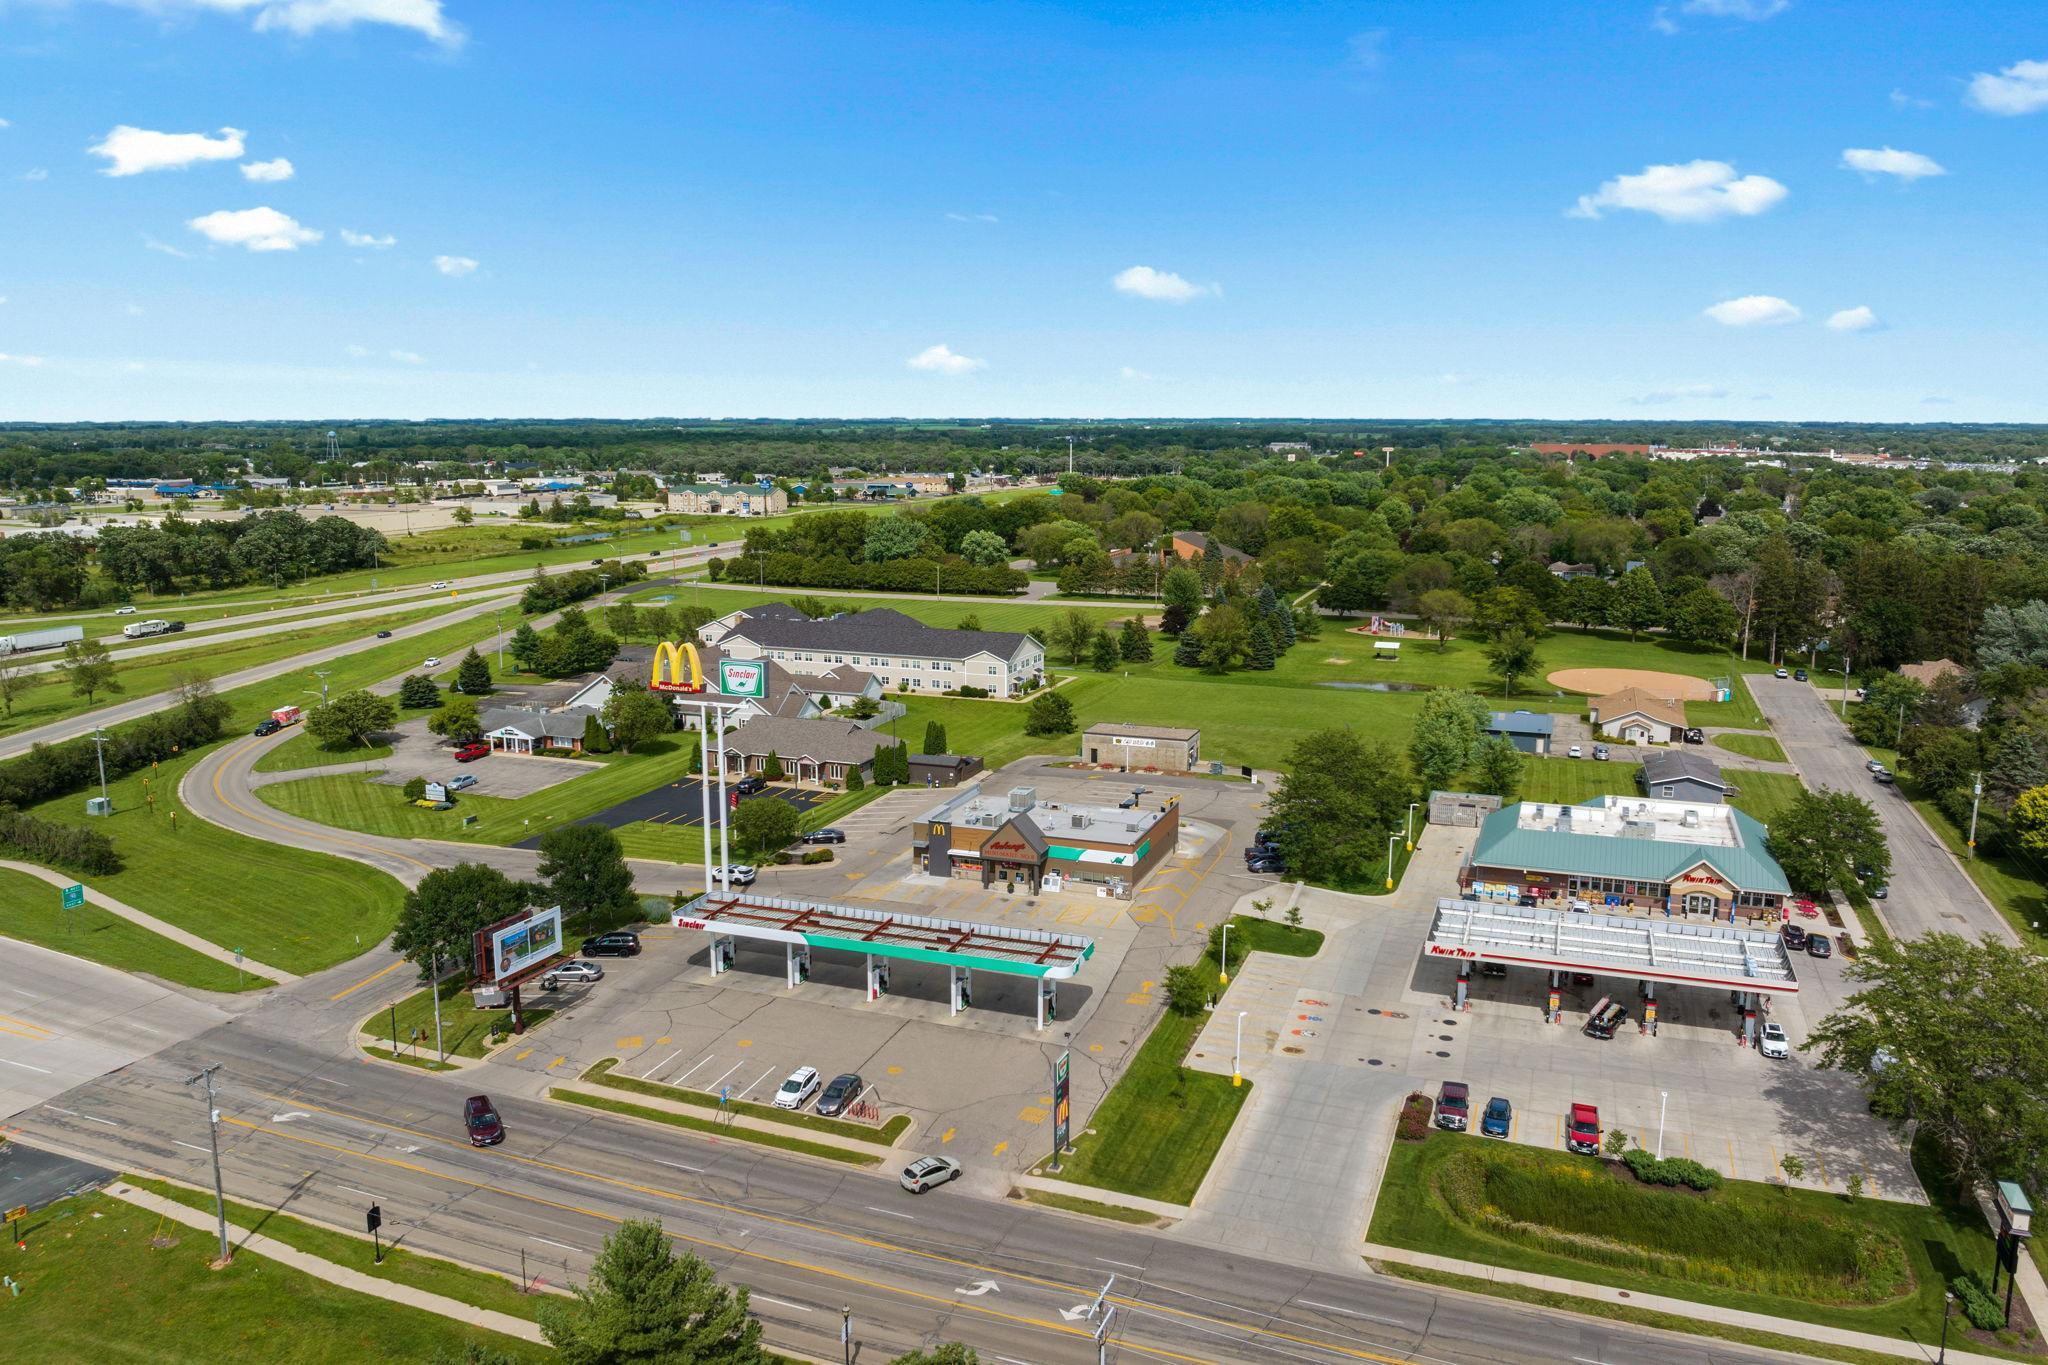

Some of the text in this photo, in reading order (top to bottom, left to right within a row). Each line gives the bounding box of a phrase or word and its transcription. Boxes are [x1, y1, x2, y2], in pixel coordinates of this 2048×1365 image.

[728, 668, 756, 679] Sinclair
[678, 919, 705, 929] Sinclair
[1431, 945, 1475, 957] KWIK TRIP
